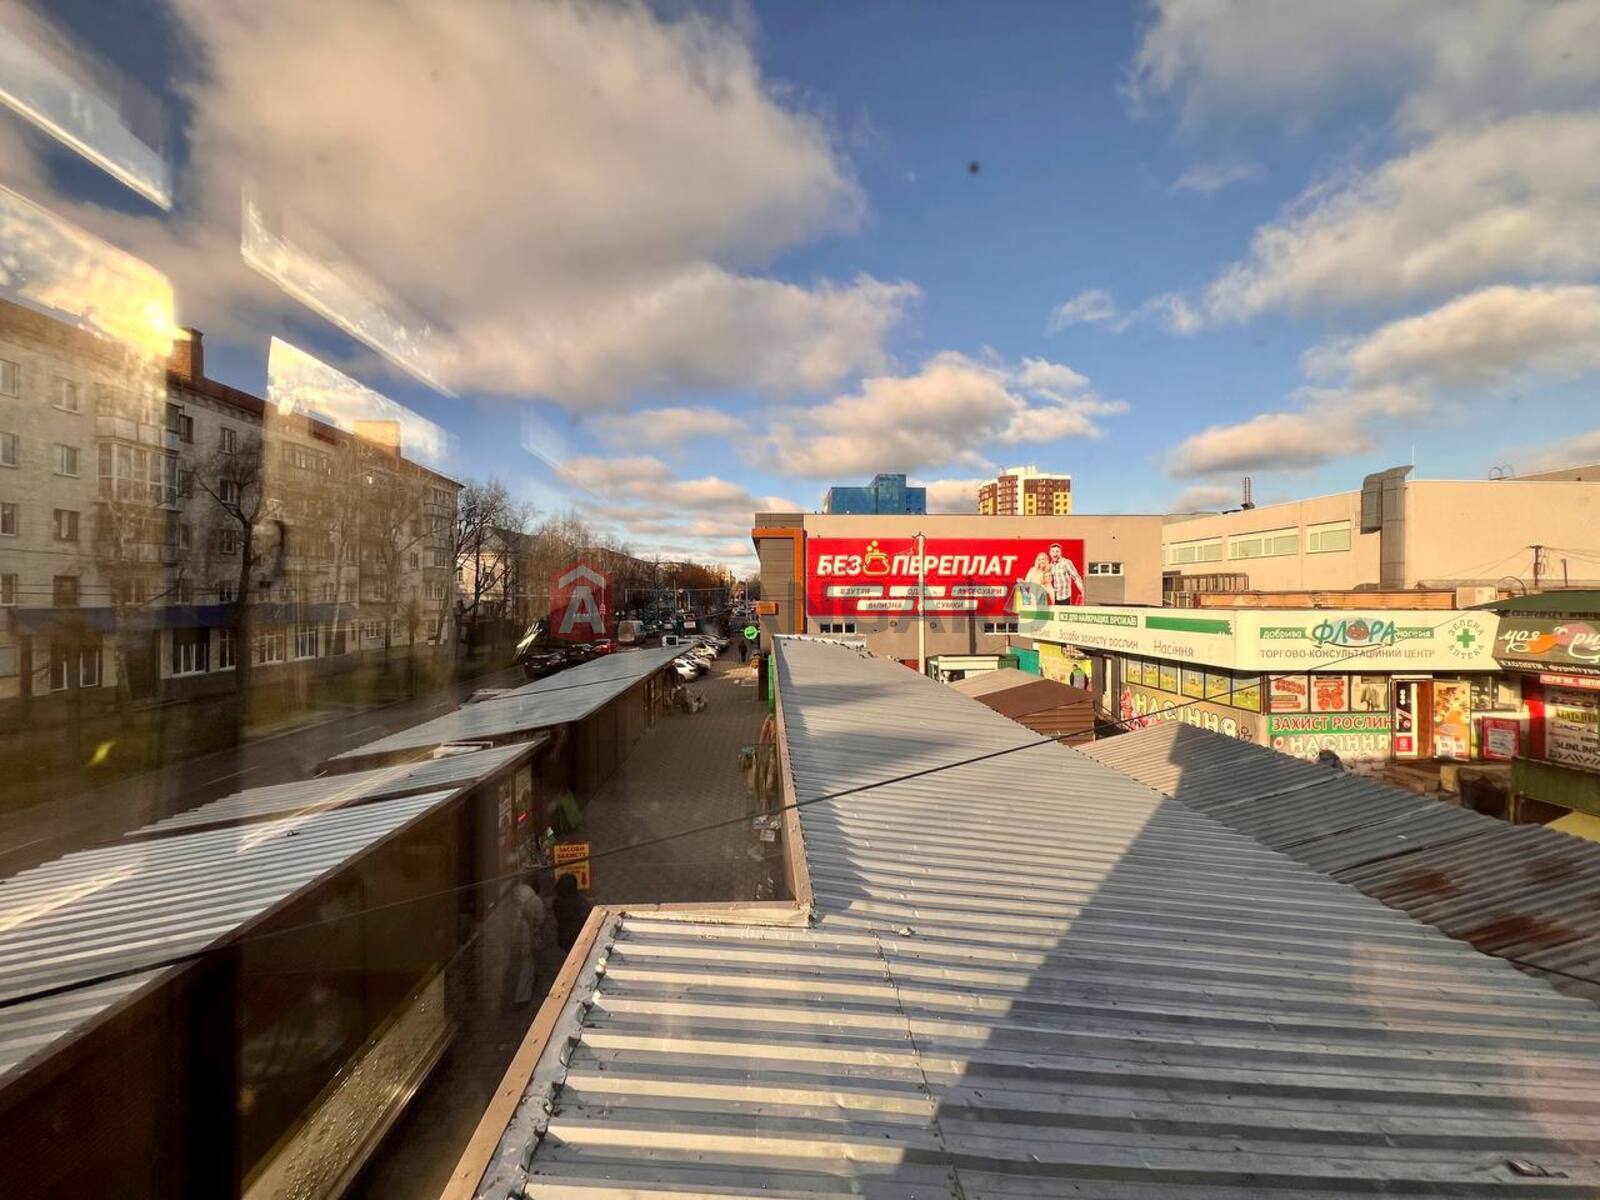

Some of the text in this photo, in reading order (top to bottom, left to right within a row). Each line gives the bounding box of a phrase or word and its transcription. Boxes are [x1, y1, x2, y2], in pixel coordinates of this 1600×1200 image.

[817, 555, 1018, 576] БЕЗ ПЕРЕПЛАТ
[1154, 640, 1194, 657] Насіння
[1404, 648, 1435, 659] ЦЕНТР
[1272, 715, 1394, 731] ЗАХИСТ РОСЛИН
[1289, 735, 1390, 752] НАСІННЯ
